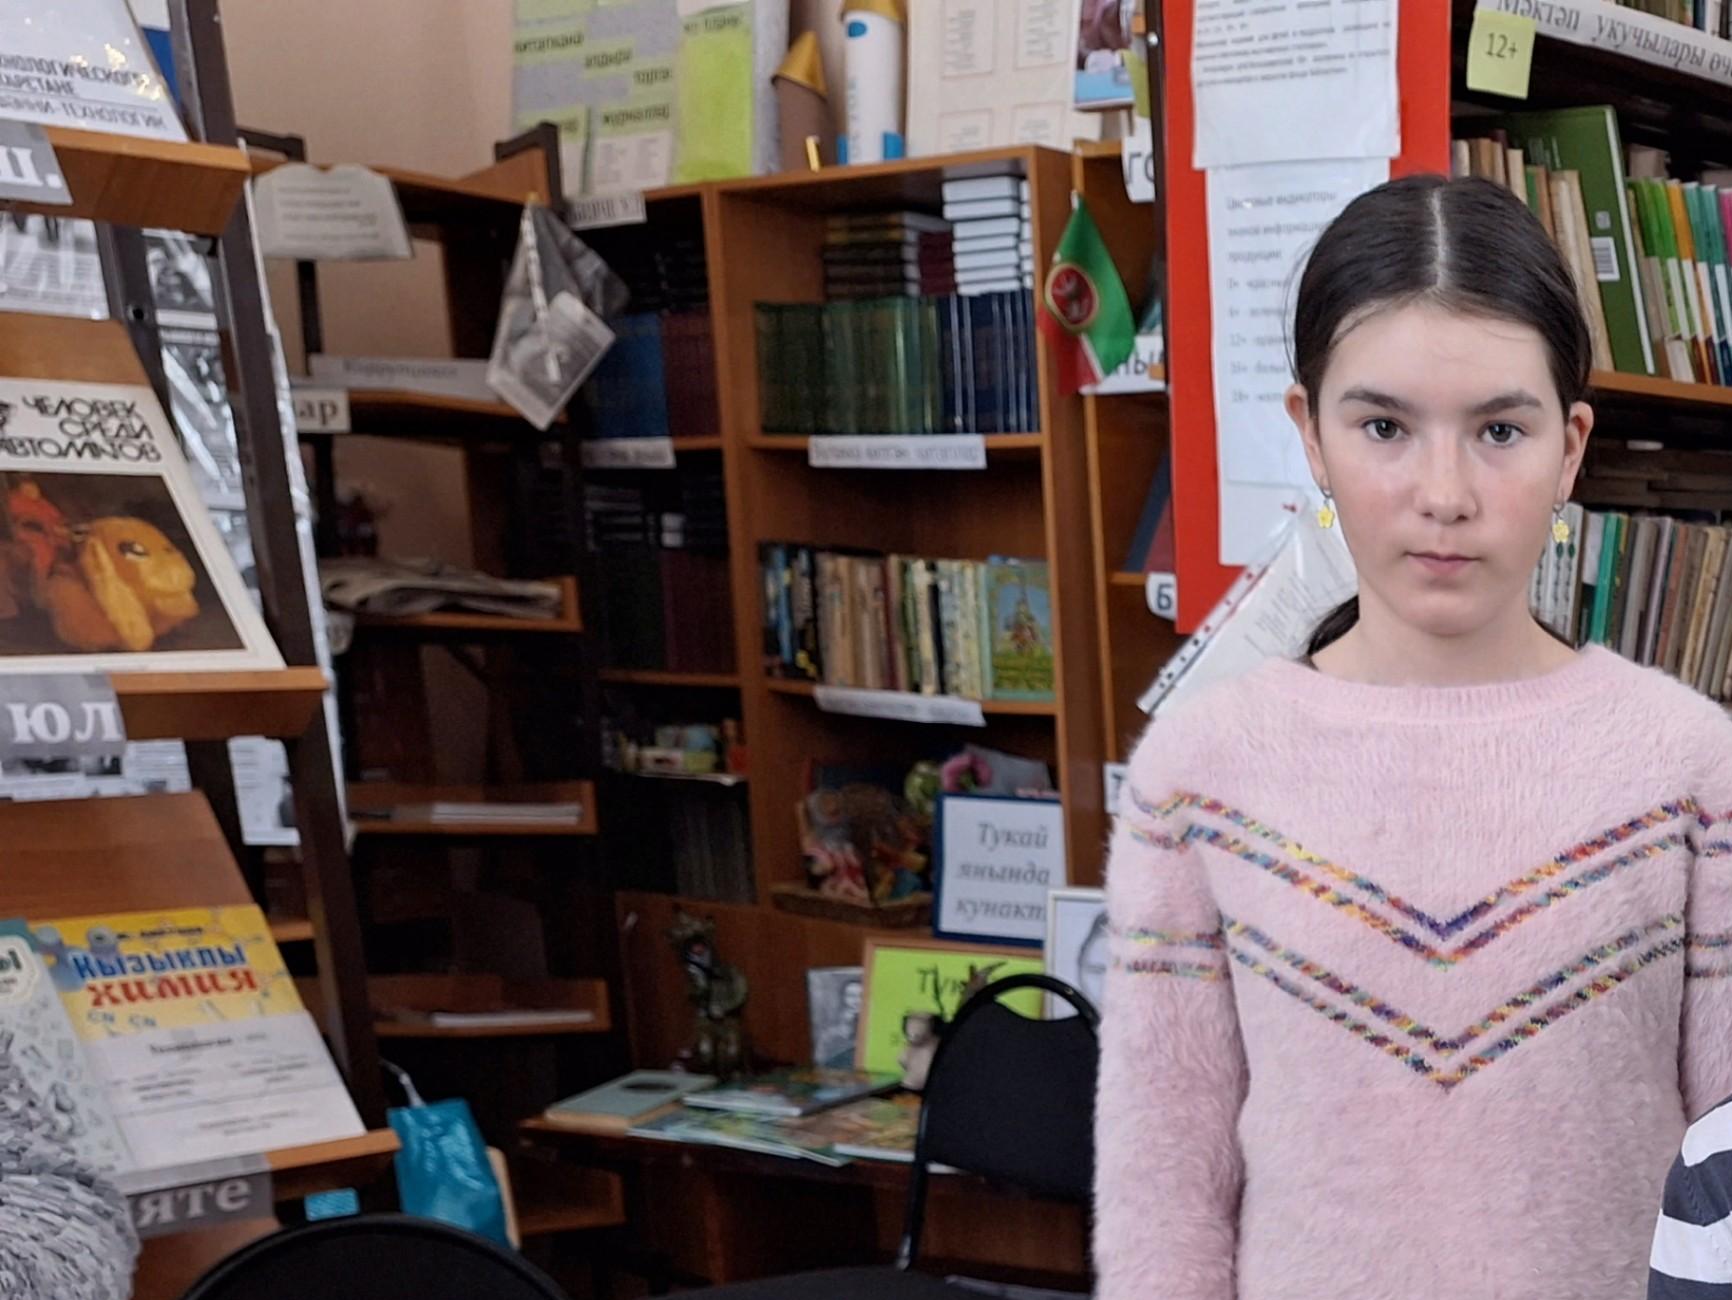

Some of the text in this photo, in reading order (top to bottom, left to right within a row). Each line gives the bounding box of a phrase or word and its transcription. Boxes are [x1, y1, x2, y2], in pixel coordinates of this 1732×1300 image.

[1485, 33, 1517, 59] 12+
[1593, 15, 1705, 67] укучылары
[978, 822, 1049, 848] Тукай
[956, 862, 1050, 882] янында
[71, 943, 247, 981] КЫЗЫКЛЫ
[86, 968, 258, 1008] ХИМИЯ
